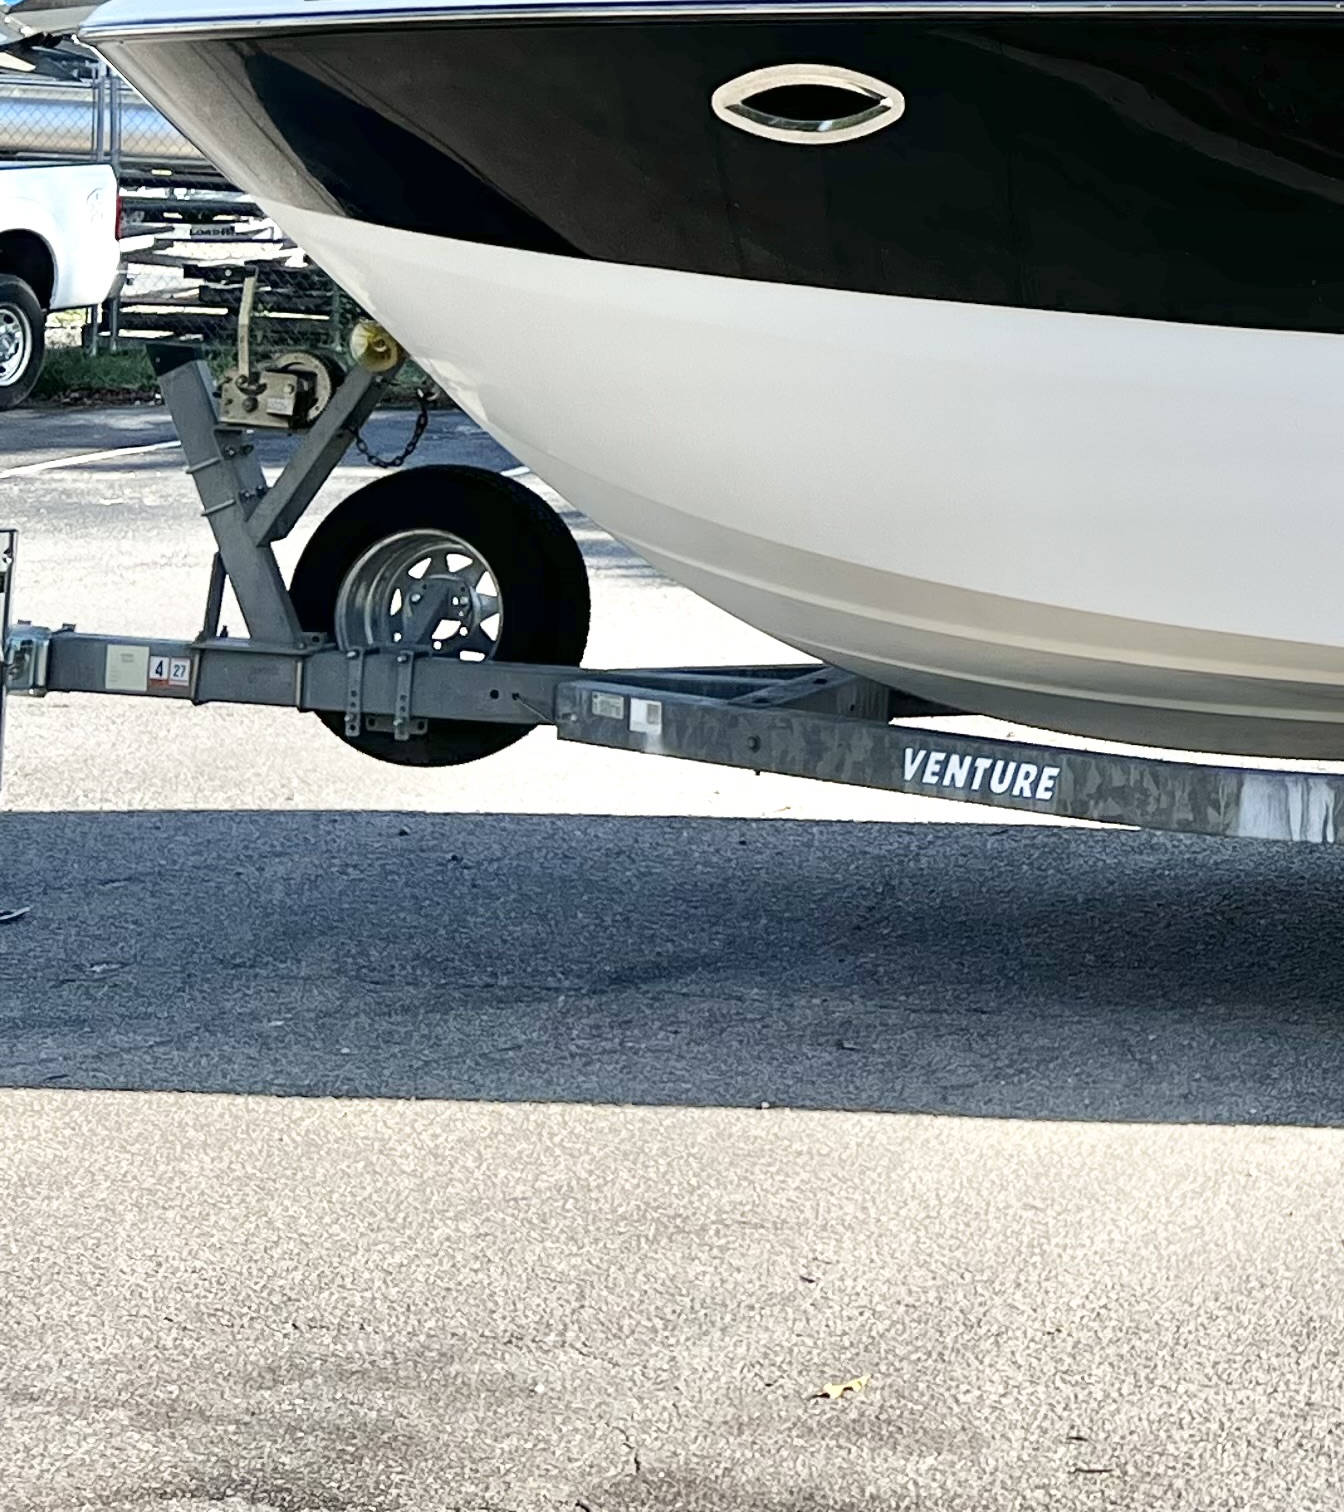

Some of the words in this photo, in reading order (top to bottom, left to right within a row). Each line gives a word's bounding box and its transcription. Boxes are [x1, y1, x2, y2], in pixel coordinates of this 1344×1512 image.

[155, 659, 163, 677] 4
[173, 664, 186, 678] 27
[903, 747, 1060, 800] VENTURE
